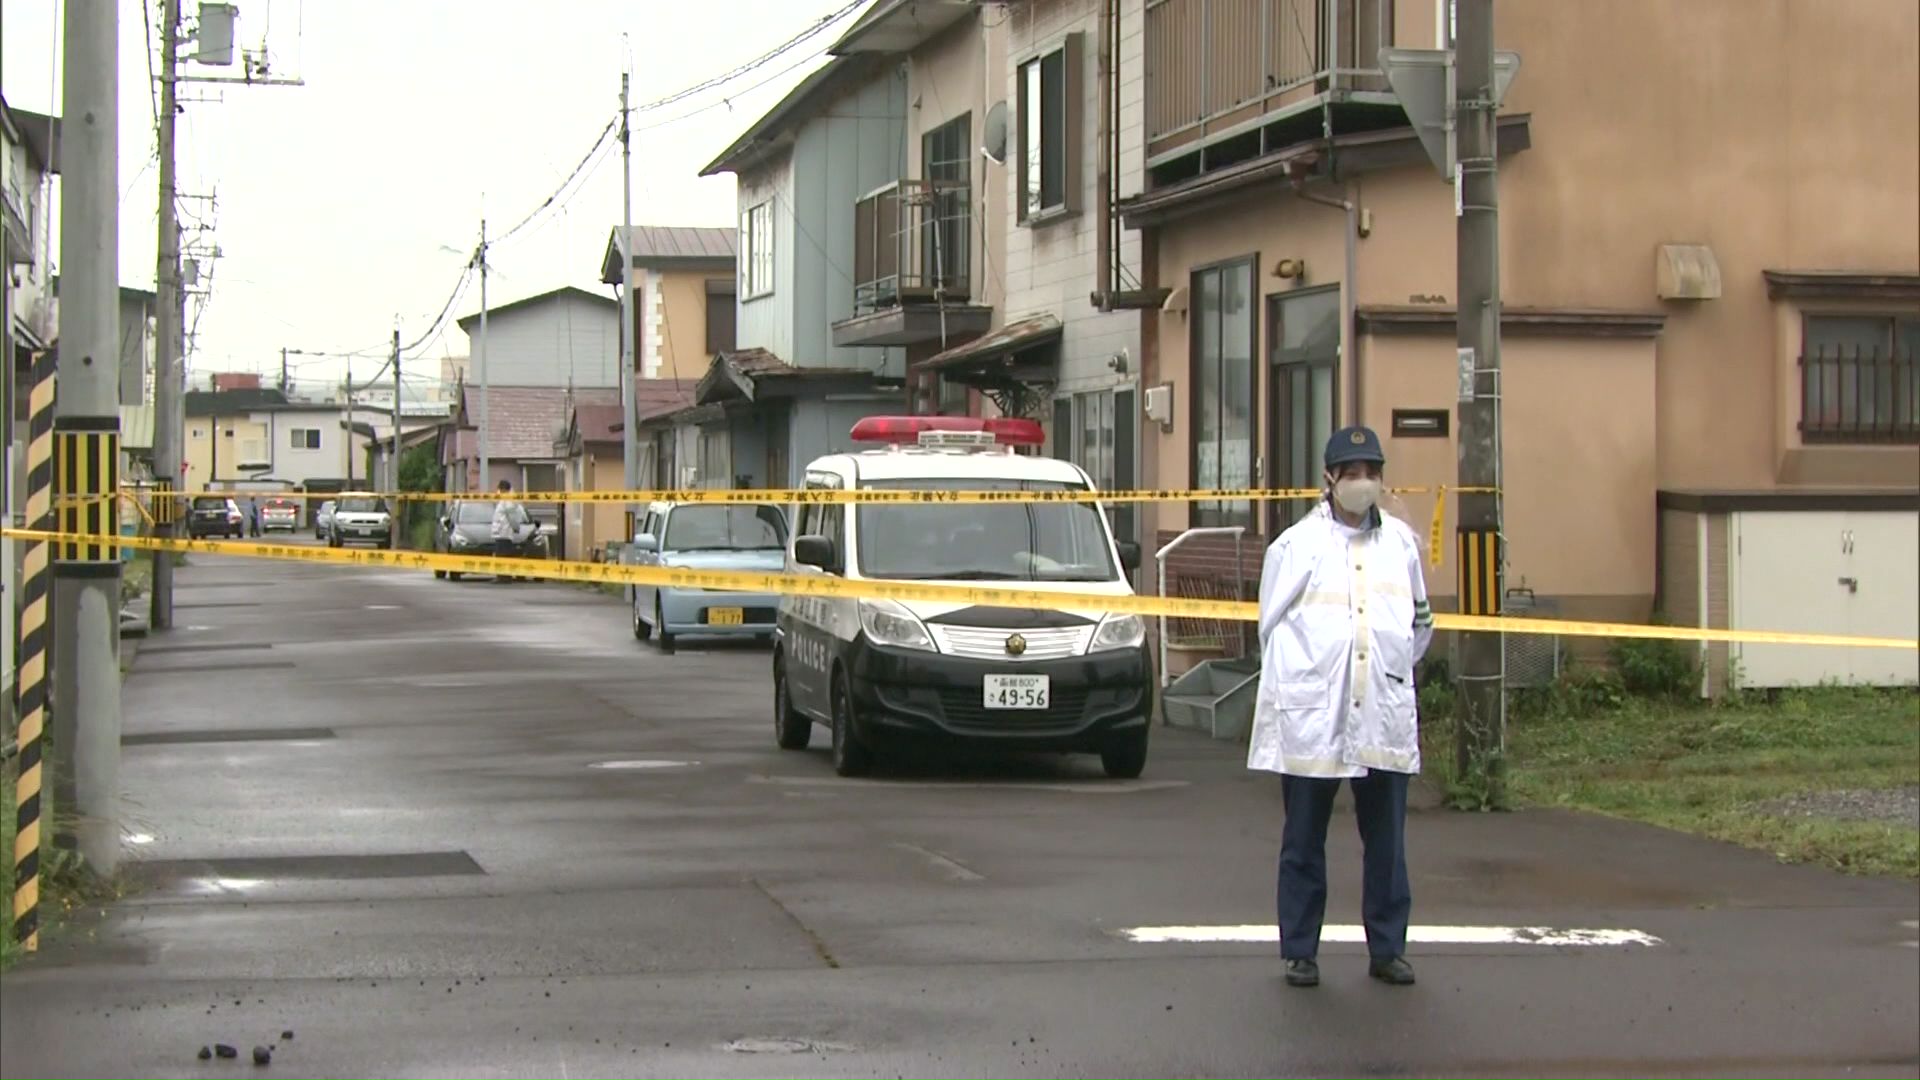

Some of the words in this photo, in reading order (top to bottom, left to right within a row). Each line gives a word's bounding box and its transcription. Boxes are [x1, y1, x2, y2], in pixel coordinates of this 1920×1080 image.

[652, 492, 706, 501] 立入禁止
[784, 492, 835, 501] 立入禁止
[791, 631, 826, 672] POLICE
[998, 688, 1045, 706] 49-56
